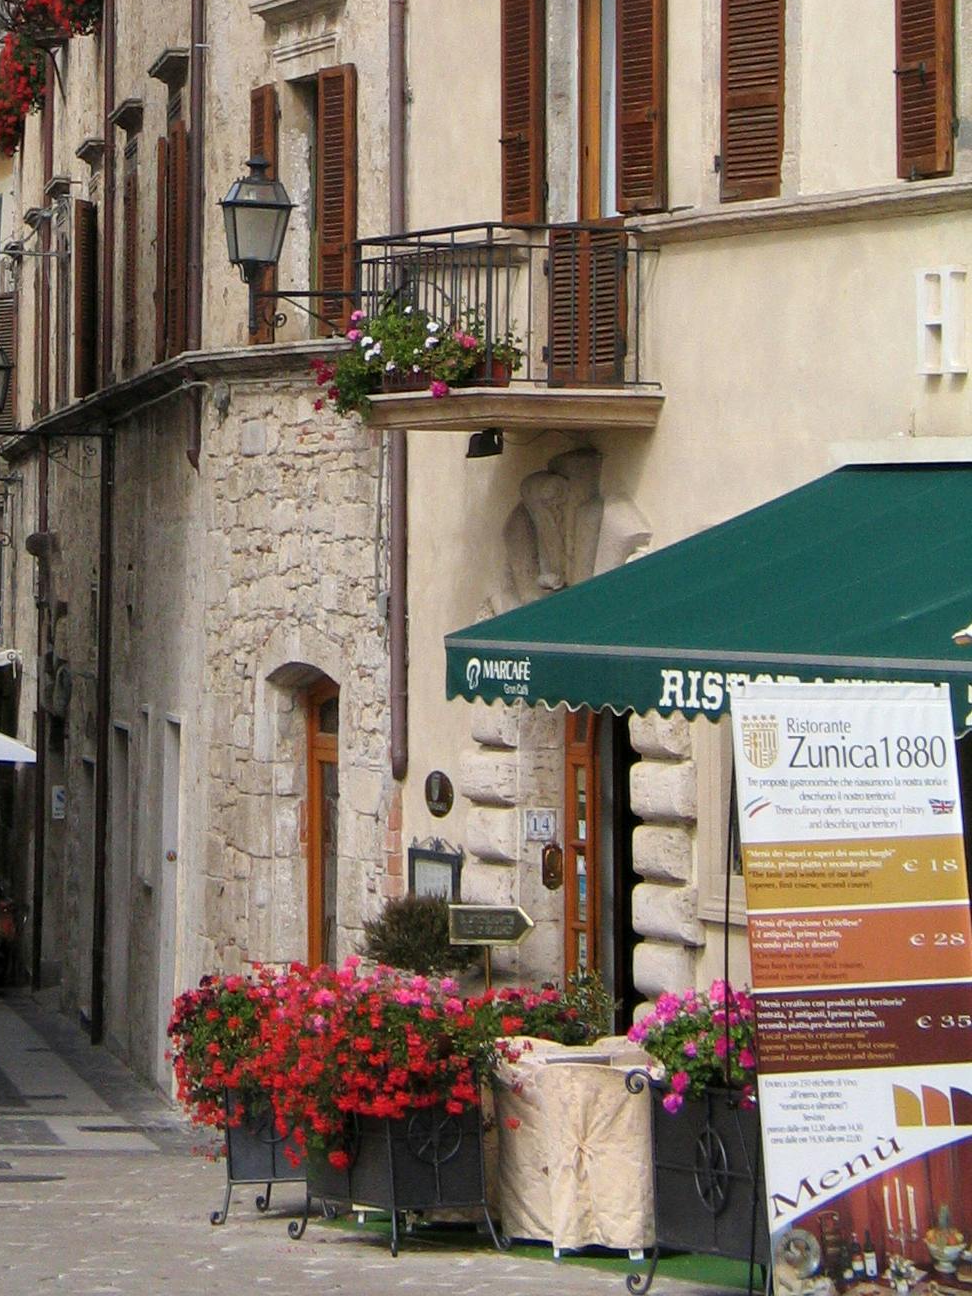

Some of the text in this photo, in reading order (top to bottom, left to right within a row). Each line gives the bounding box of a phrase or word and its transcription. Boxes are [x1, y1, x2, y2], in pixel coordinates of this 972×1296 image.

[482, 656, 531, 681] MARCAFÈ
[787, 717, 852, 734] Ristorante
[788, 735, 947, 769] Zunica1880
[775, 805, 793, 816] Three
[794, 805, 822, 817] culinary
[532, 817, 550, 833] 14
[809, 819, 823, 829] and
[901, 858, 959, 873] € 18
[909, 932, 965, 947] € 28
[915, 1014, 972, 1029] € 35
[769, 1136, 904, 1218] Menù
